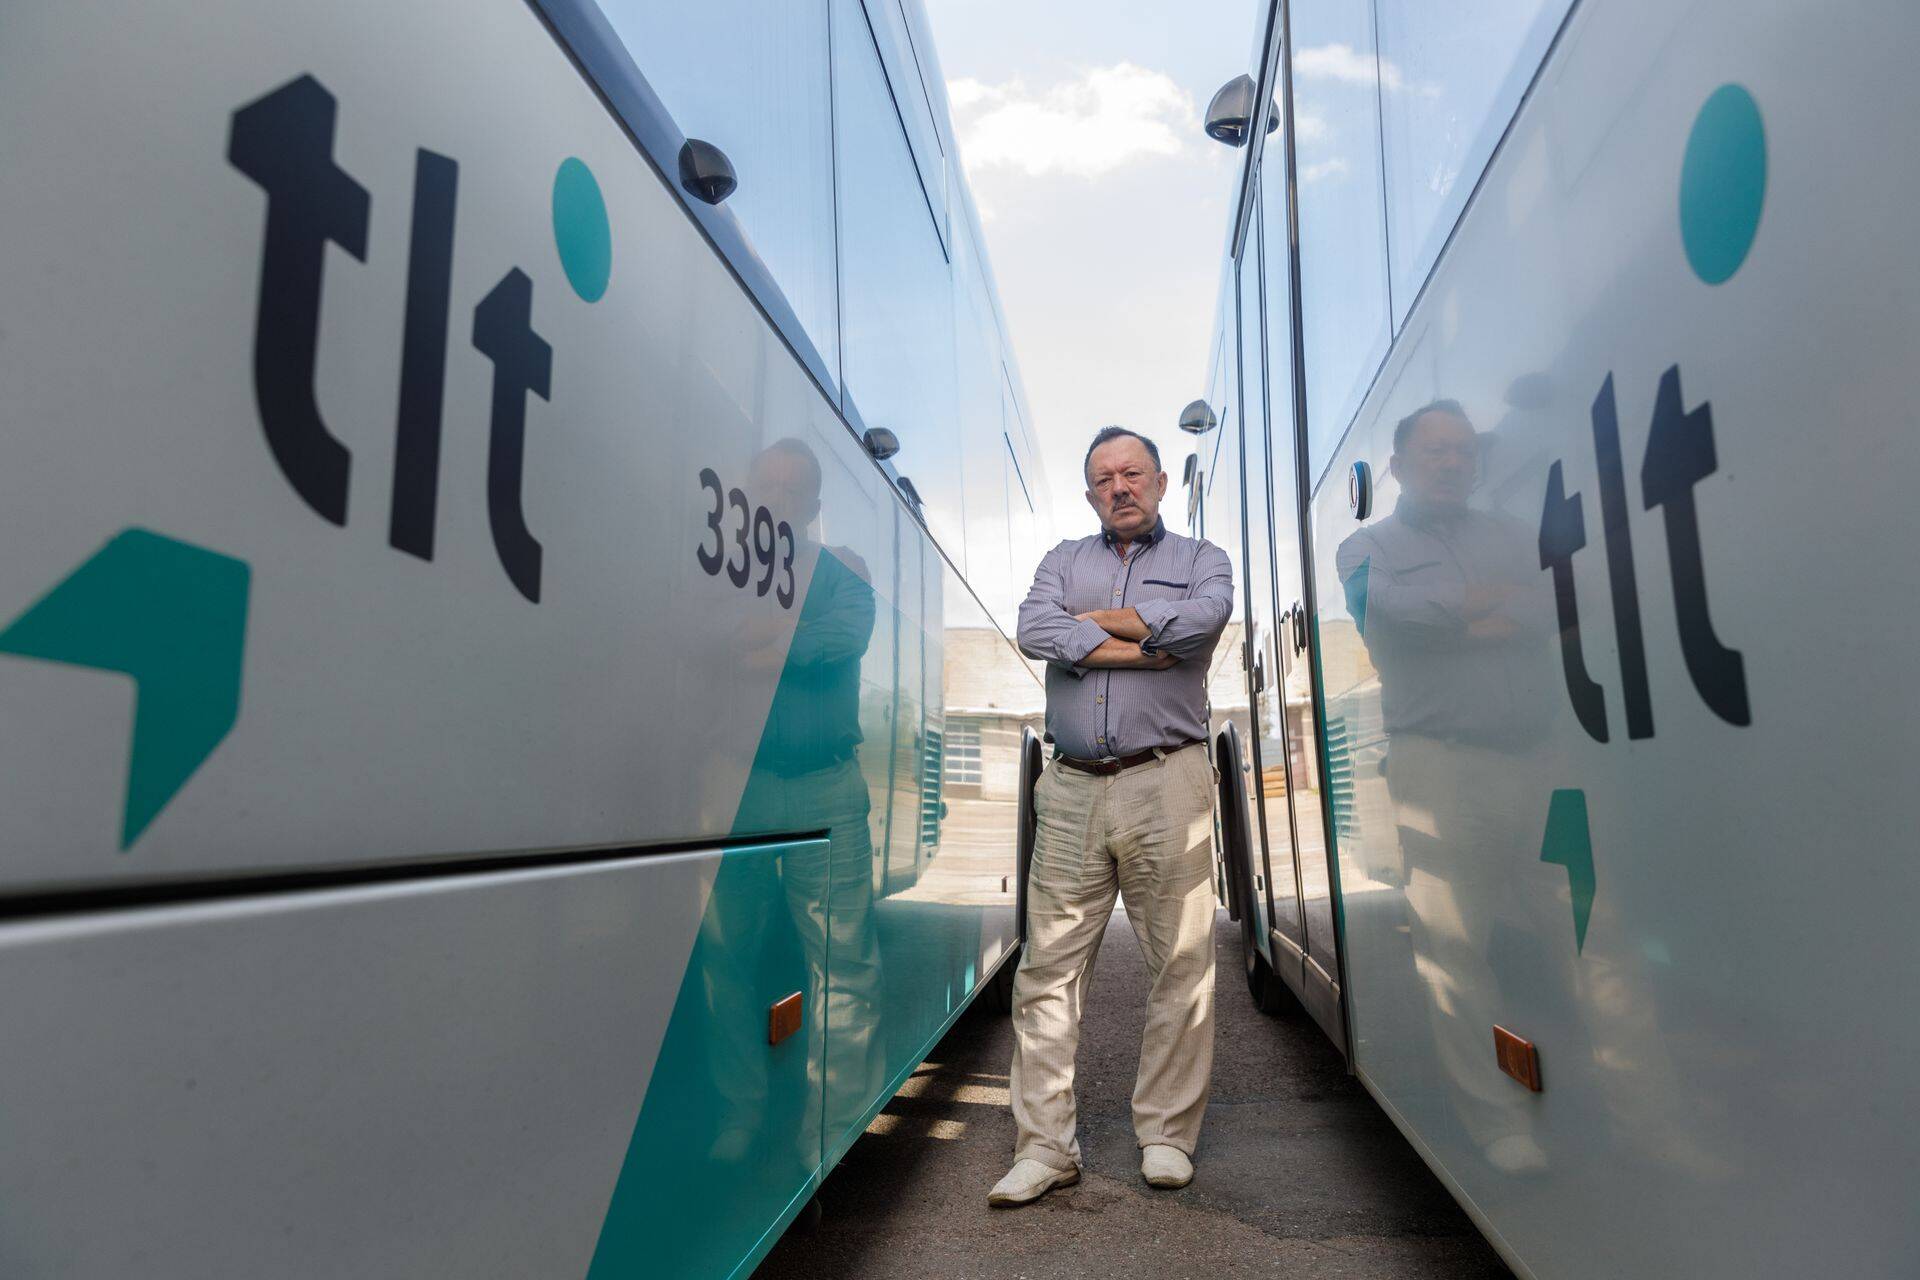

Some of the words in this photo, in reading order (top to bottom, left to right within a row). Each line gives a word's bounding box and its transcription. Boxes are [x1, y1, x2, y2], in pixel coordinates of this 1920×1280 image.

[226, 73, 553, 605] tlt
[697, 467, 795, 610] 3393
[1538, 363, 1751, 744] tlt
